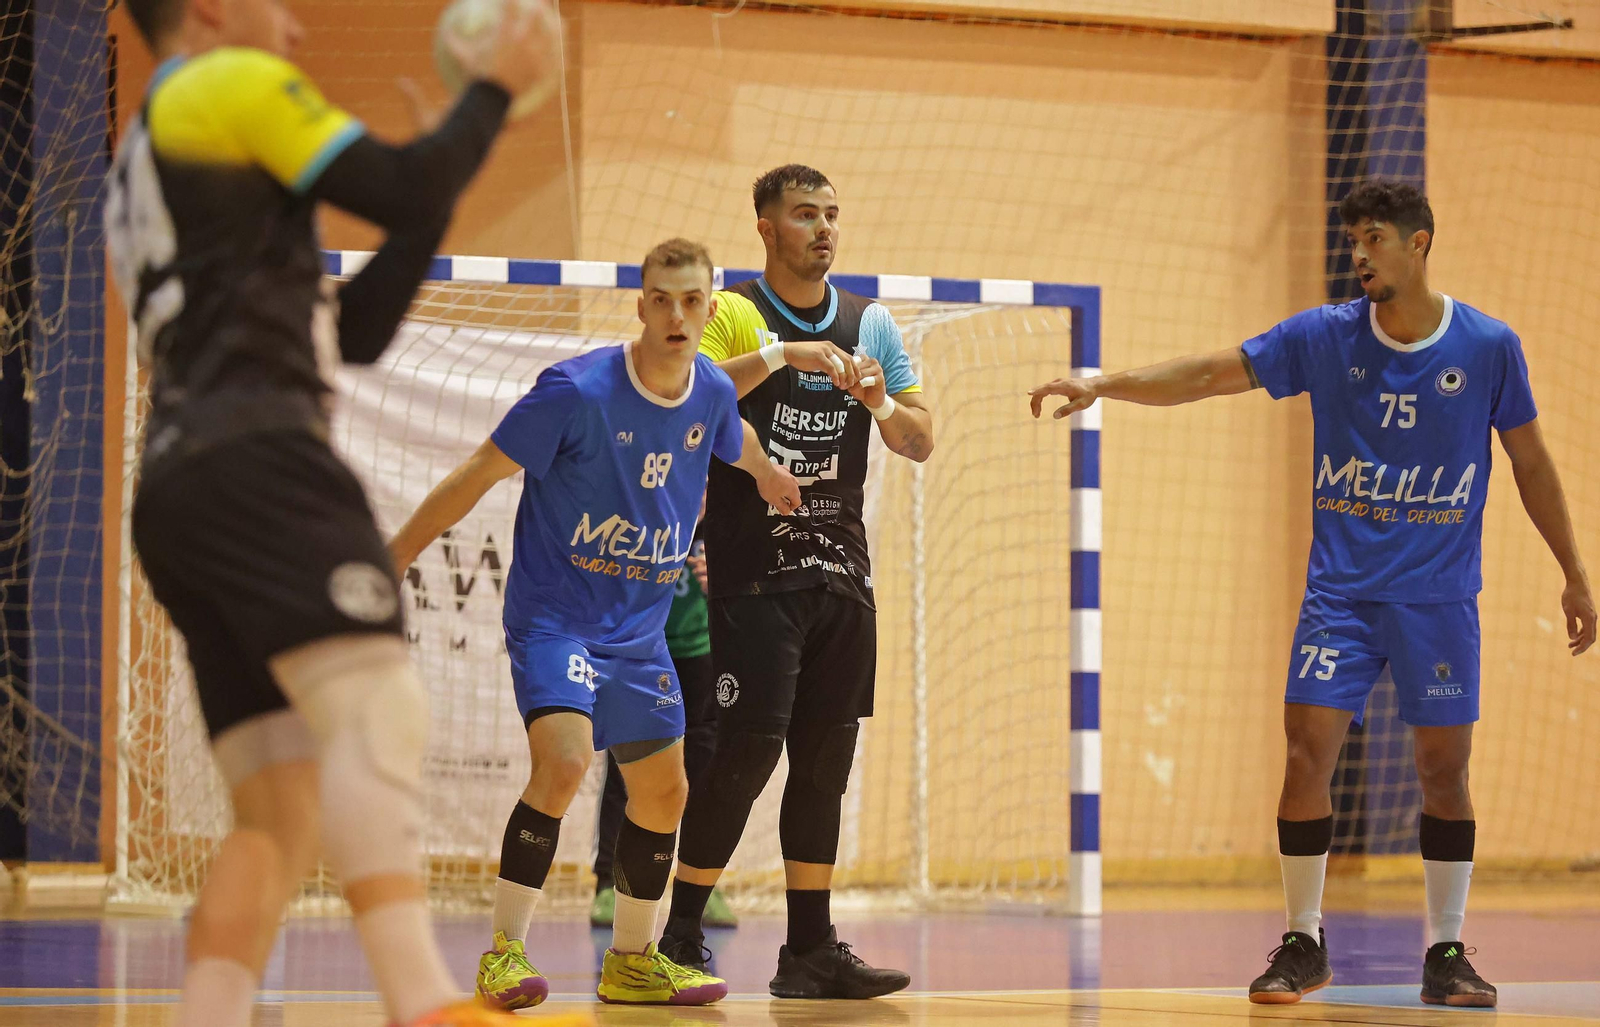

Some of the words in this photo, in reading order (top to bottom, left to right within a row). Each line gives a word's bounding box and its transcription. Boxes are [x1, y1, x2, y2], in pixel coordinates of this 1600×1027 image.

[773, 402, 848, 432] IBERSUR
[1379, 392, 1418, 429] 75
[771, 421, 801, 441] Energía
[640, 452, 673, 489] 89
[1315, 454, 1477, 507] MELILLA
[1316, 496, 1370, 517] CIUDAD
[1373, 506, 1400, 523] DEL
[1407, 509, 1466, 525] DEPORTE
[570, 512, 699, 565] MELILL
[571, 554, 622, 577] CIUDAD
[626, 565, 650, 582] DEL
[656, 566, 684, 585] DEP
[1298, 644, 1340, 681] 75
[1427, 687, 1463, 697] MELILLA
